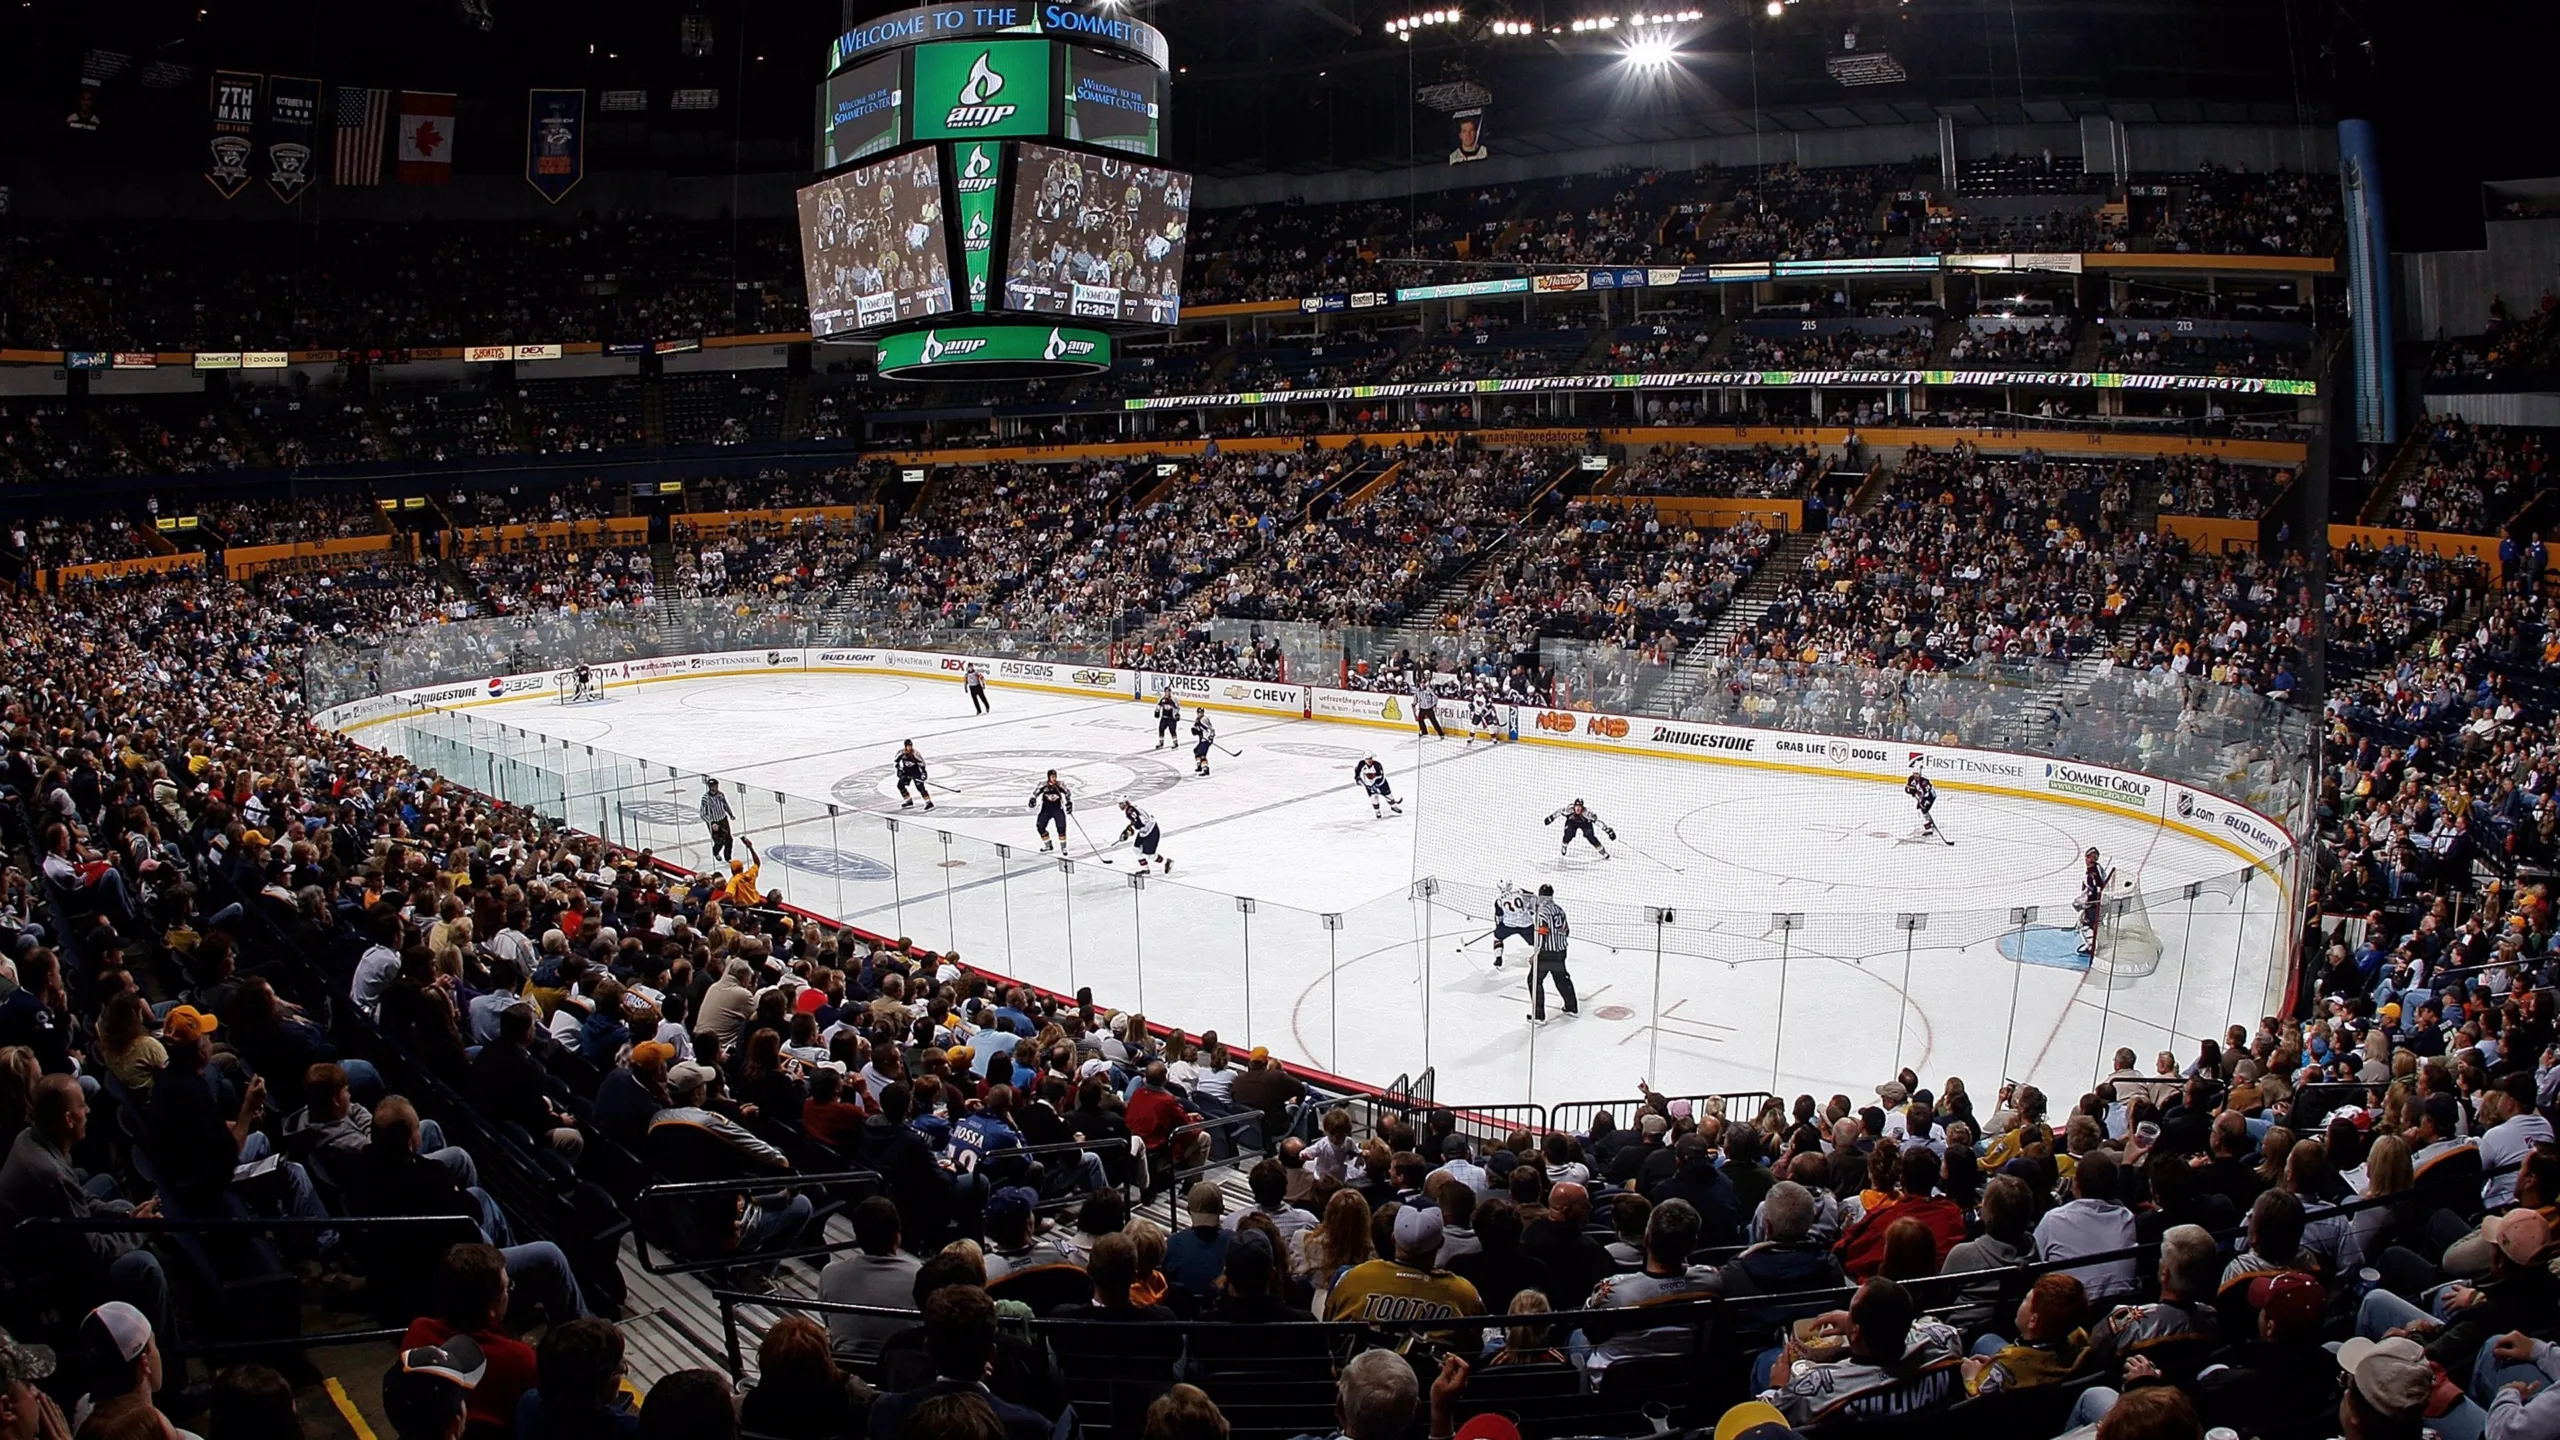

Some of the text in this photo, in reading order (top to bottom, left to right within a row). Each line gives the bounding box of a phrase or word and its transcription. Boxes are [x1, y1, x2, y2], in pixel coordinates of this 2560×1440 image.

[840, 15, 924, 56] WELCOME
[933, 10, 964, 30] TO
[973, 8, 1017, 27] THE
[1046, 5, 1132, 41] SOMMET
[219, 87, 254, 106] 7TH
[1077, 86, 1147, 114] SOMMET CENTER
[218, 105, 251, 121] MAN
[824, 318, 833, 335] 2
[862, 311, 886, 326] 12:26
[926, 297, 936, 315] 0
[1023, 294, 1035, 311] 2
[1055, 300, 1065, 309] 27
[1076, 303, 1106, 316] 12:26
[1126, 307, 1135, 316] 17
[1151, 306, 1162, 323] 0
[1652, 326, 1667, 336] 216
[1801, 320, 1817, 331] 215
[2177, 320, 2193, 332] 213
[1475, 334, 1488, 344] 217
[521, 346, 546, 354] DEX
[253, 356, 287, 364] DODGE
[821, 652, 876, 662] BUD LIGHT
[941, 658, 966, 672] DEX
[503, 677, 543, 691] PEPSI
[413, 687, 478, 704] BRIDGESTONE
[1254, 688, 1297, 703] CHEVY
[1435, 706, 1455, 719] OPEN
[1651, 726, 1756, 752] BRIDGESTONE
[1776, 740, 1826, 755] GRAB LIFE
[1852, 749, 1888, 762] DODGE
[1926, 755, 2024, 778] FIRST TENNESSEE
[2060, 766, 2150, 797] SOMMET GROUP
[2192, 805, 2215, 823] .com
[2224, 814, 2278, 851] BUD LIGHT
[1553, 914, 1564, 928] 21
[1845, 1370, 1950, 1416] SULLIVAN
